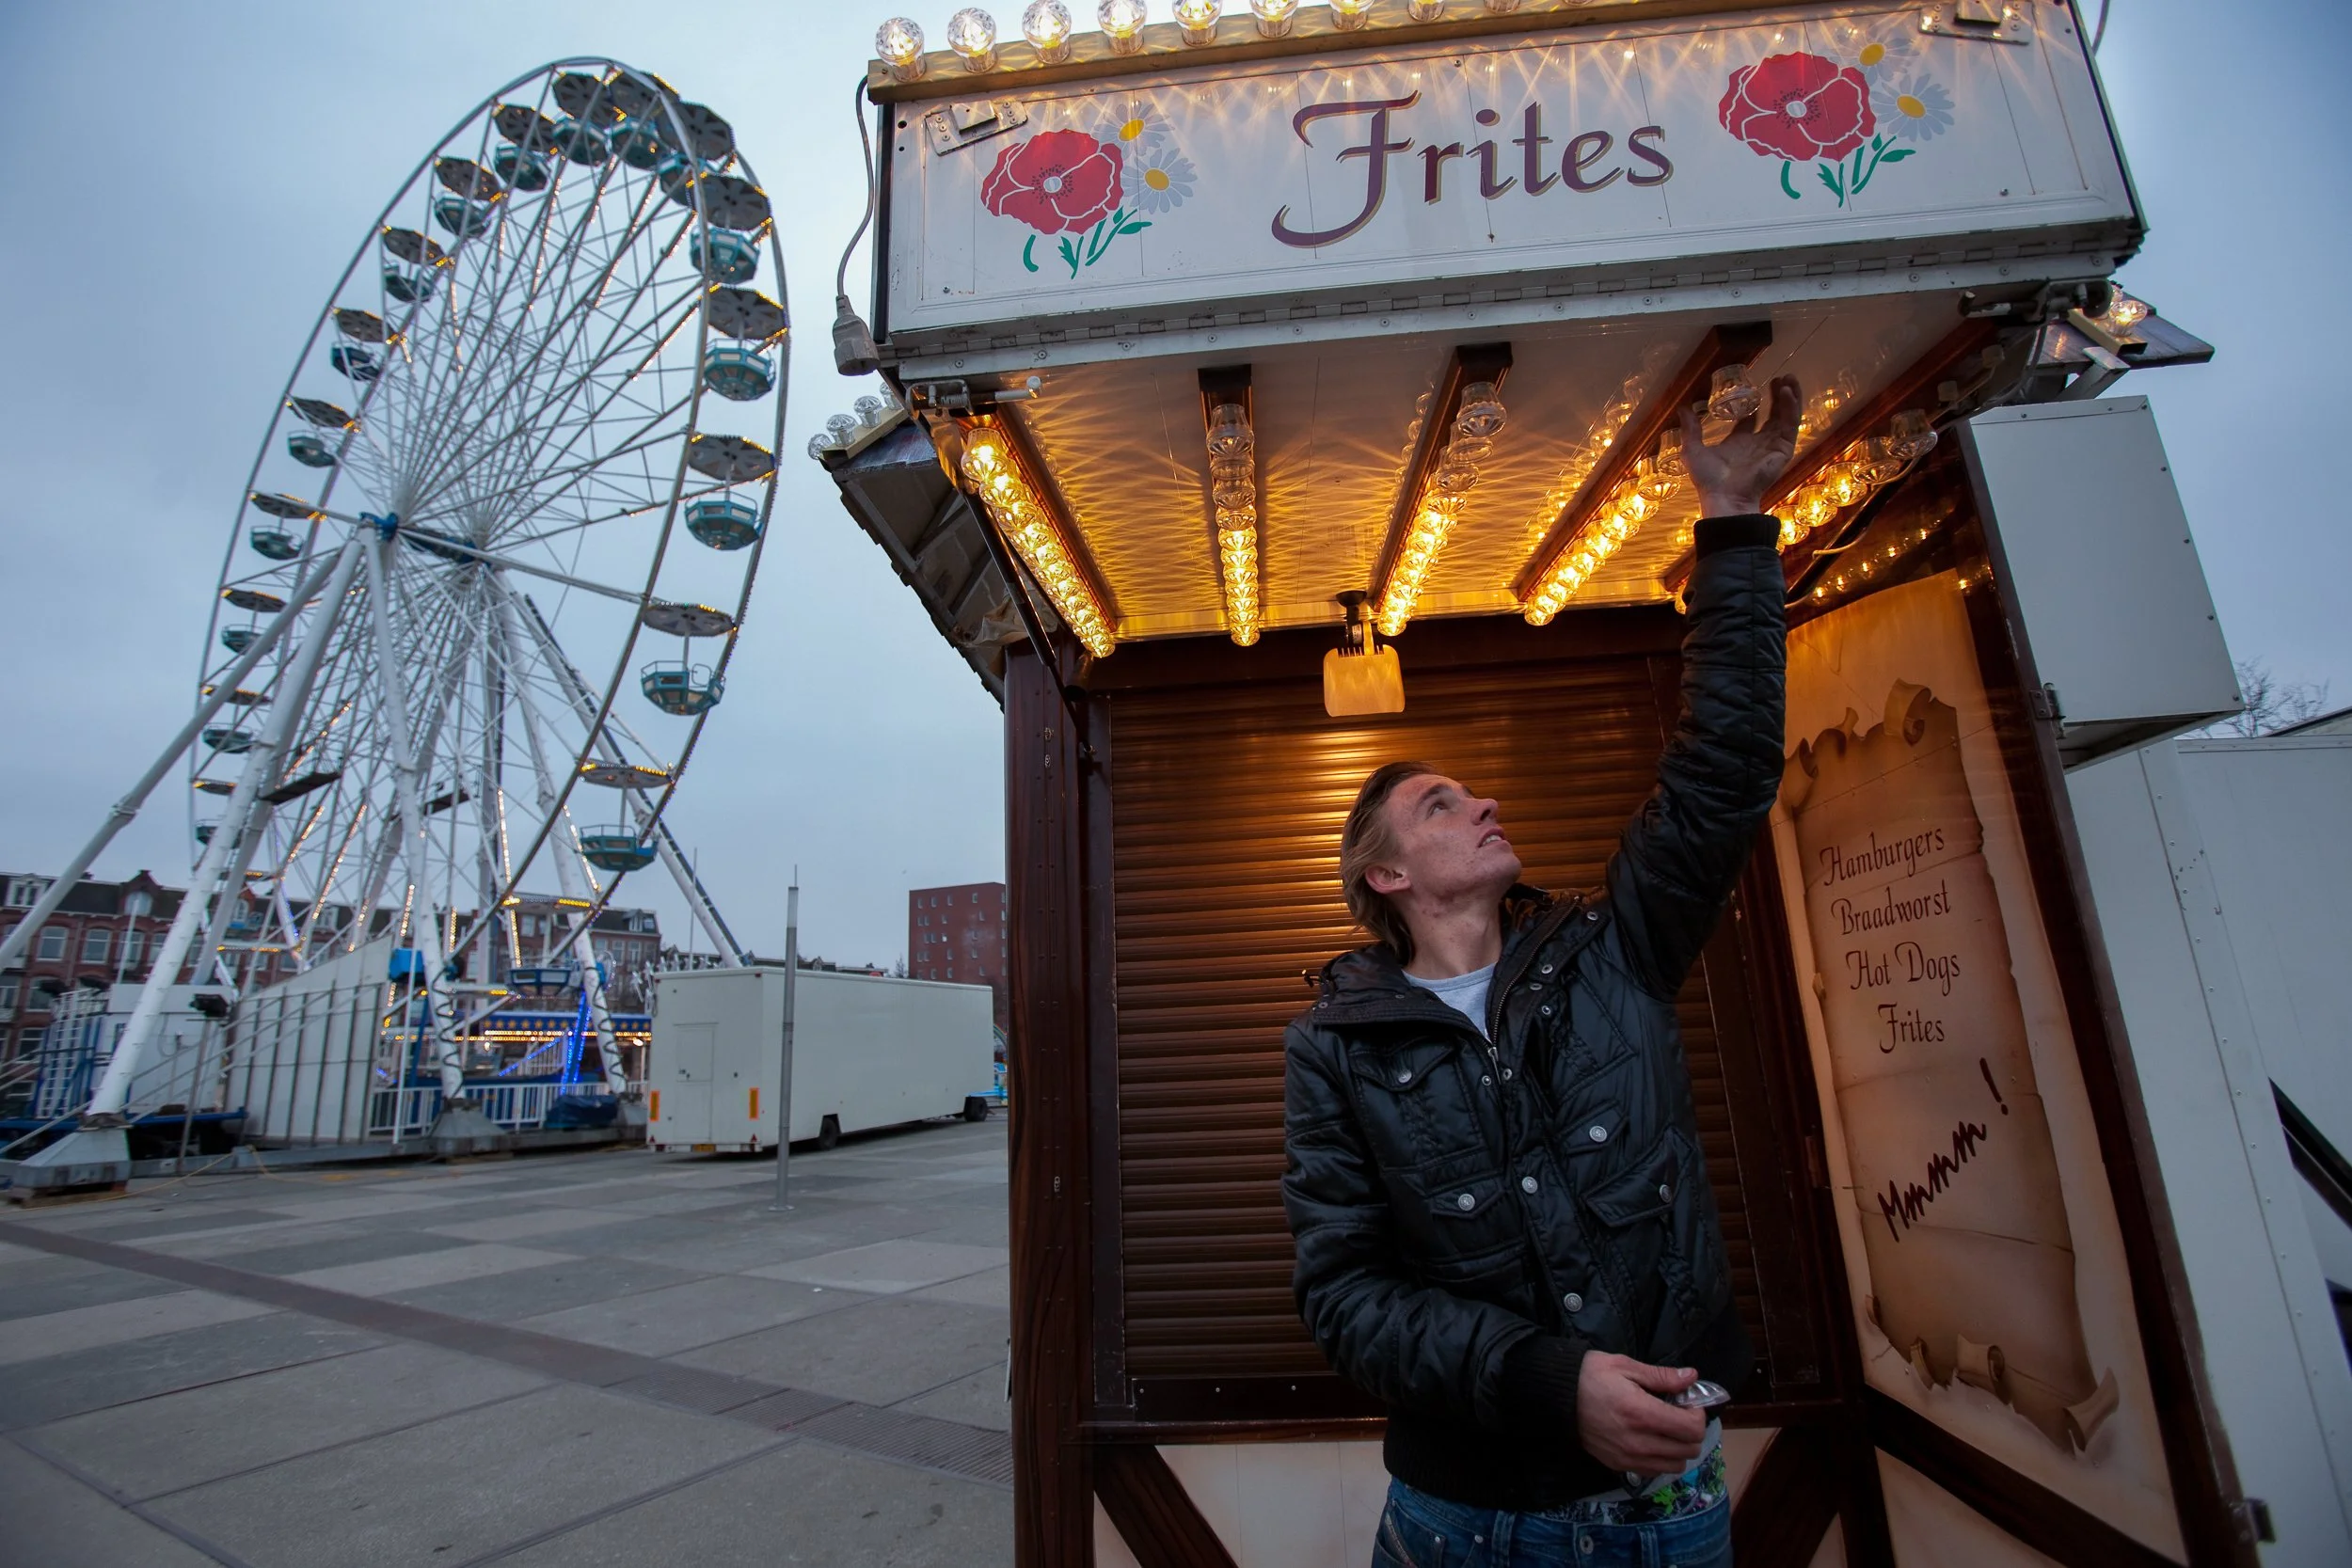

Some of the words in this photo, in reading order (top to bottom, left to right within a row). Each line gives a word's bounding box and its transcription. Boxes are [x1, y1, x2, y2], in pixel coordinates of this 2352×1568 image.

[1271, 90, 1674, 247] Frites
[1820, 828, 1945, 886] Hamburgers
[1831, 879, 1951, 935] Braadworst
[1846, 949, 1892, 990] Hot
[1894, 941, 1961, 997] Dogs
[1877, 1002, 1945, 1054] Frites
